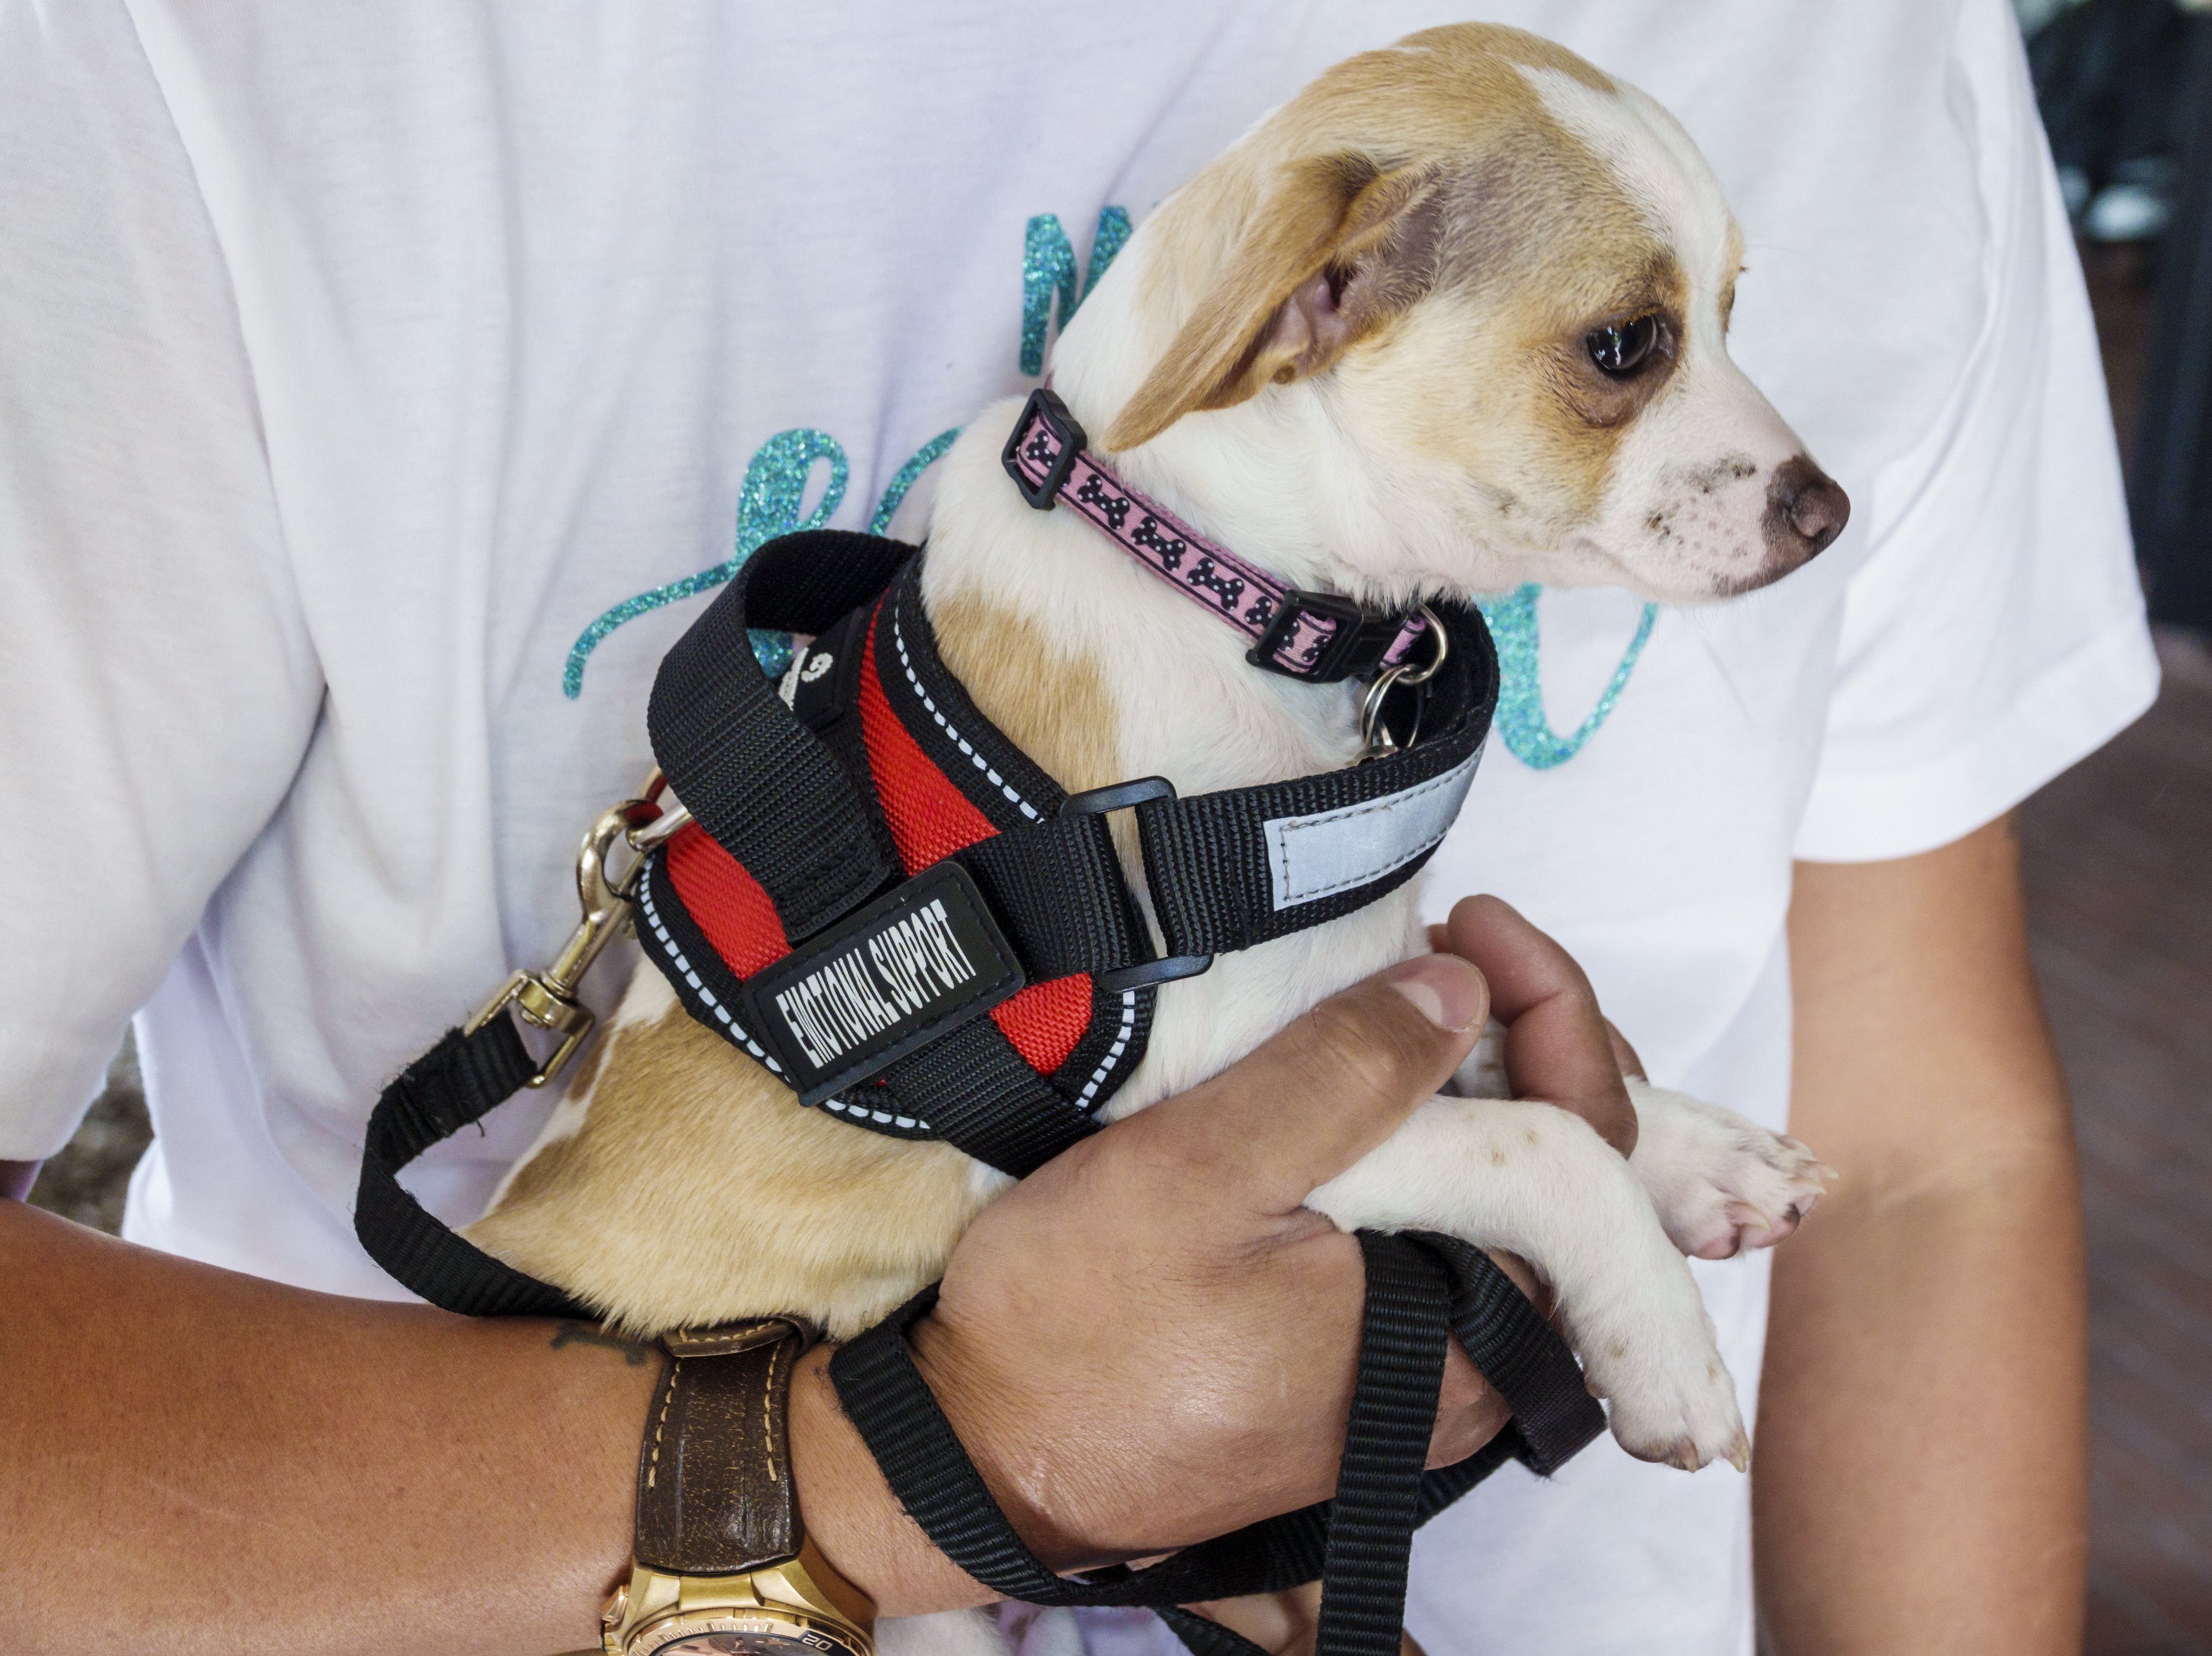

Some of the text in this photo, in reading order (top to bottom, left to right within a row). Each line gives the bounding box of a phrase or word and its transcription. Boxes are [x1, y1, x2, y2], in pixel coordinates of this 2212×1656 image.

[775, 899, 976, 1069] EMOTIONAL SUPPORT
[802, 1634, 833, 1651] 20
